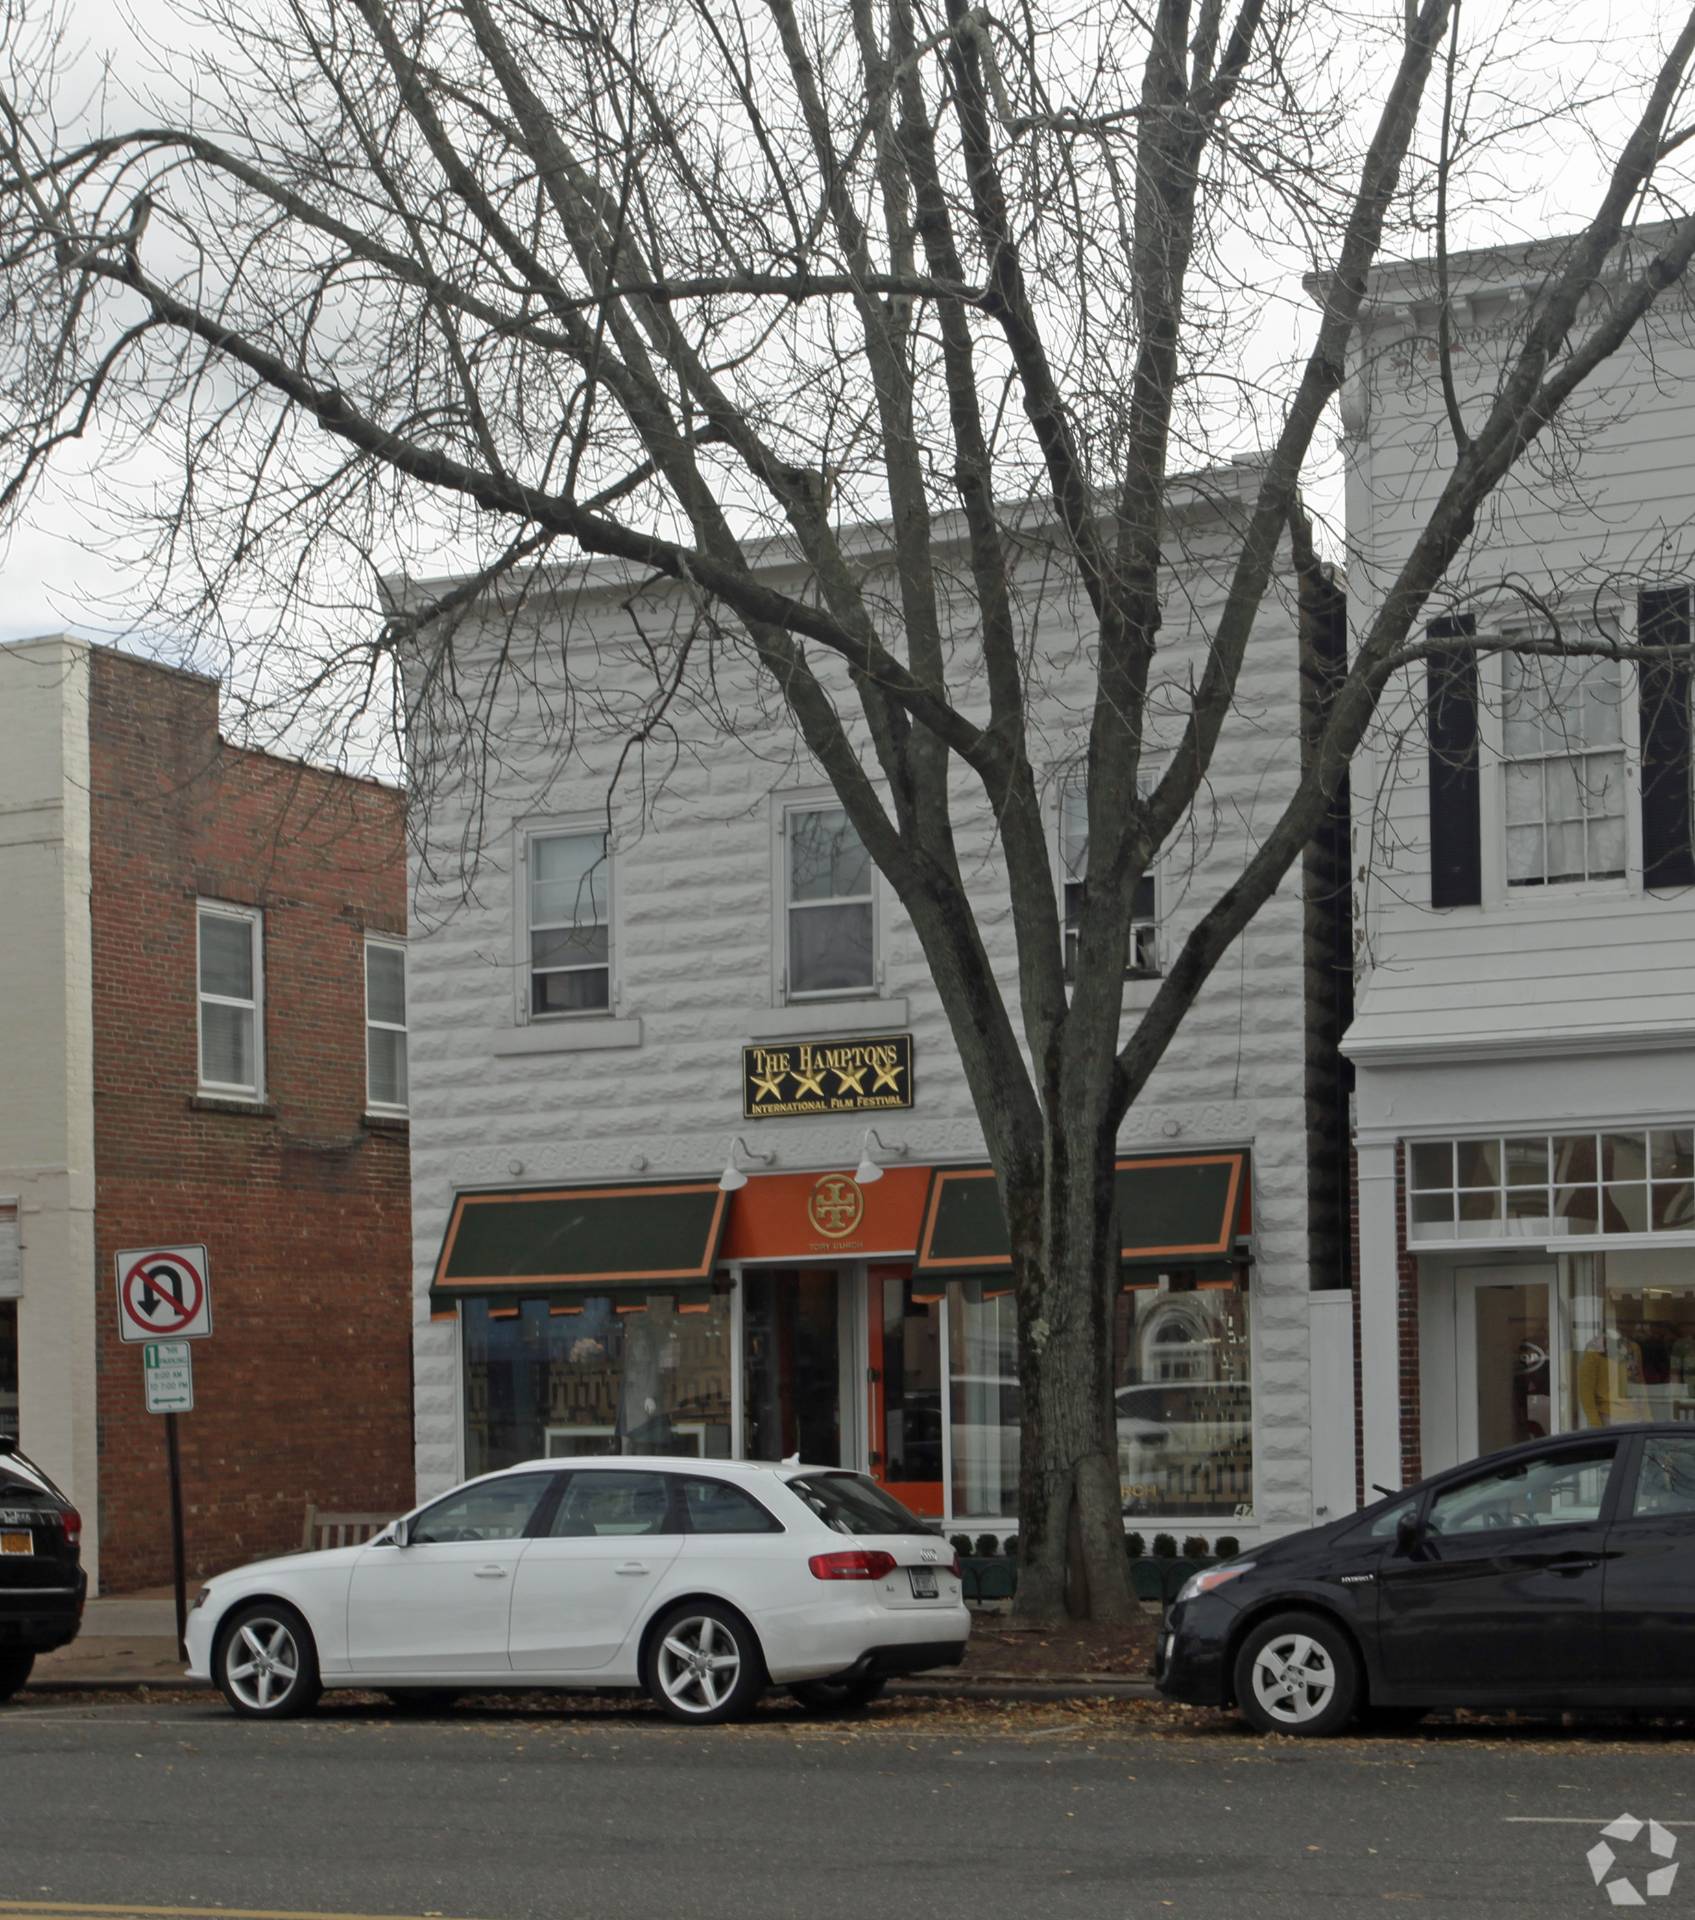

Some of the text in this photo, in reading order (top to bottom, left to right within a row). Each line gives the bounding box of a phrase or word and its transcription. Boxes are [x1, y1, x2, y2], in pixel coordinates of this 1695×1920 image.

[753, 1044, 897, 1073] THE HAMPTONS
[752, 1095, 902, 1114] INTERNATIONAL FILM FESTIVAL
[173, 1370, 183, 1378] AM
[1120, 1484, 1157, 1497] RCH
